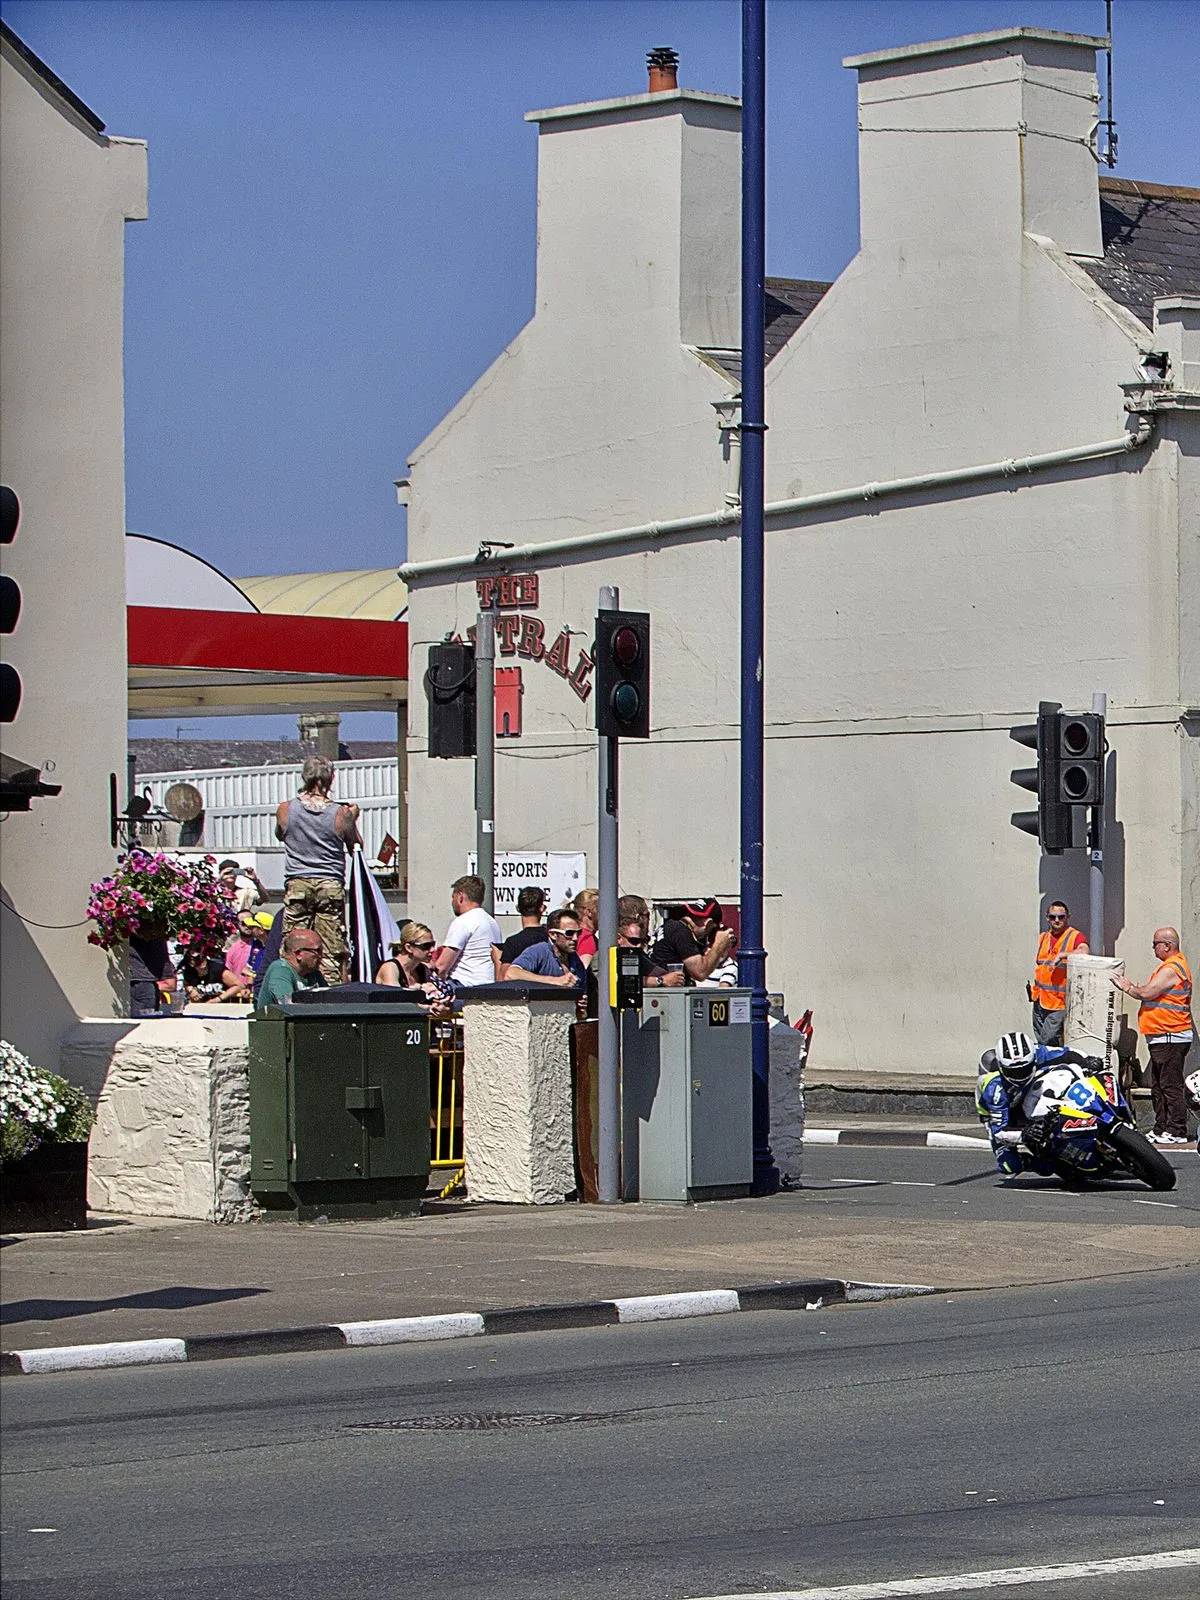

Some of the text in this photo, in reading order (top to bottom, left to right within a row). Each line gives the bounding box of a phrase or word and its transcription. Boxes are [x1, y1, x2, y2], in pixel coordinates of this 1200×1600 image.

[476, 574, 539, 609] THE
[502, 862, 548, 878] SPORTS
[711, 1003, 726, 1022] 60
[406, 1029, 421, 1045] 20
[1067, 1083, 1093, 1107] 8
